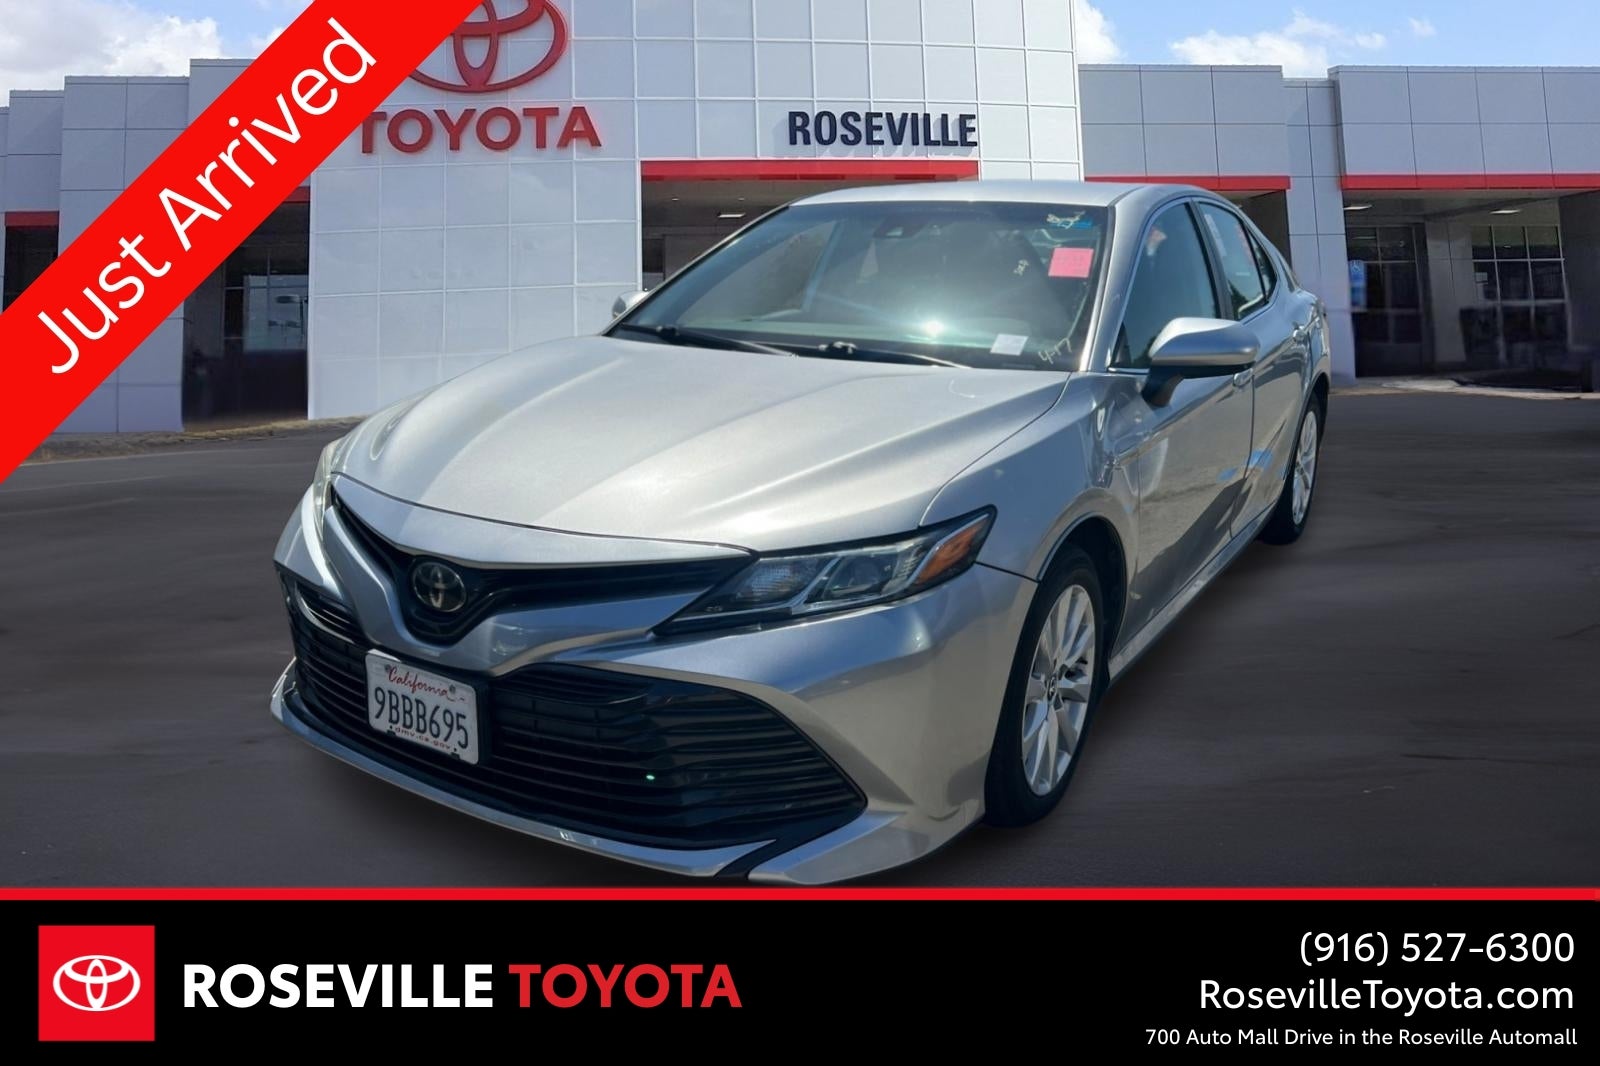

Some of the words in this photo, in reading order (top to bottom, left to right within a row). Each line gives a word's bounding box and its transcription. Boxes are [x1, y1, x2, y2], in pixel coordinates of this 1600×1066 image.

[361, 105, 602, 154] TOYOTA
[788, 111, 978, 147] ROSEVILLE
[388, 665, 452, 699] California
[374, 686, 469, 750] 9BBB695
[394, 726, 452, 751] dmv.ca.gov
